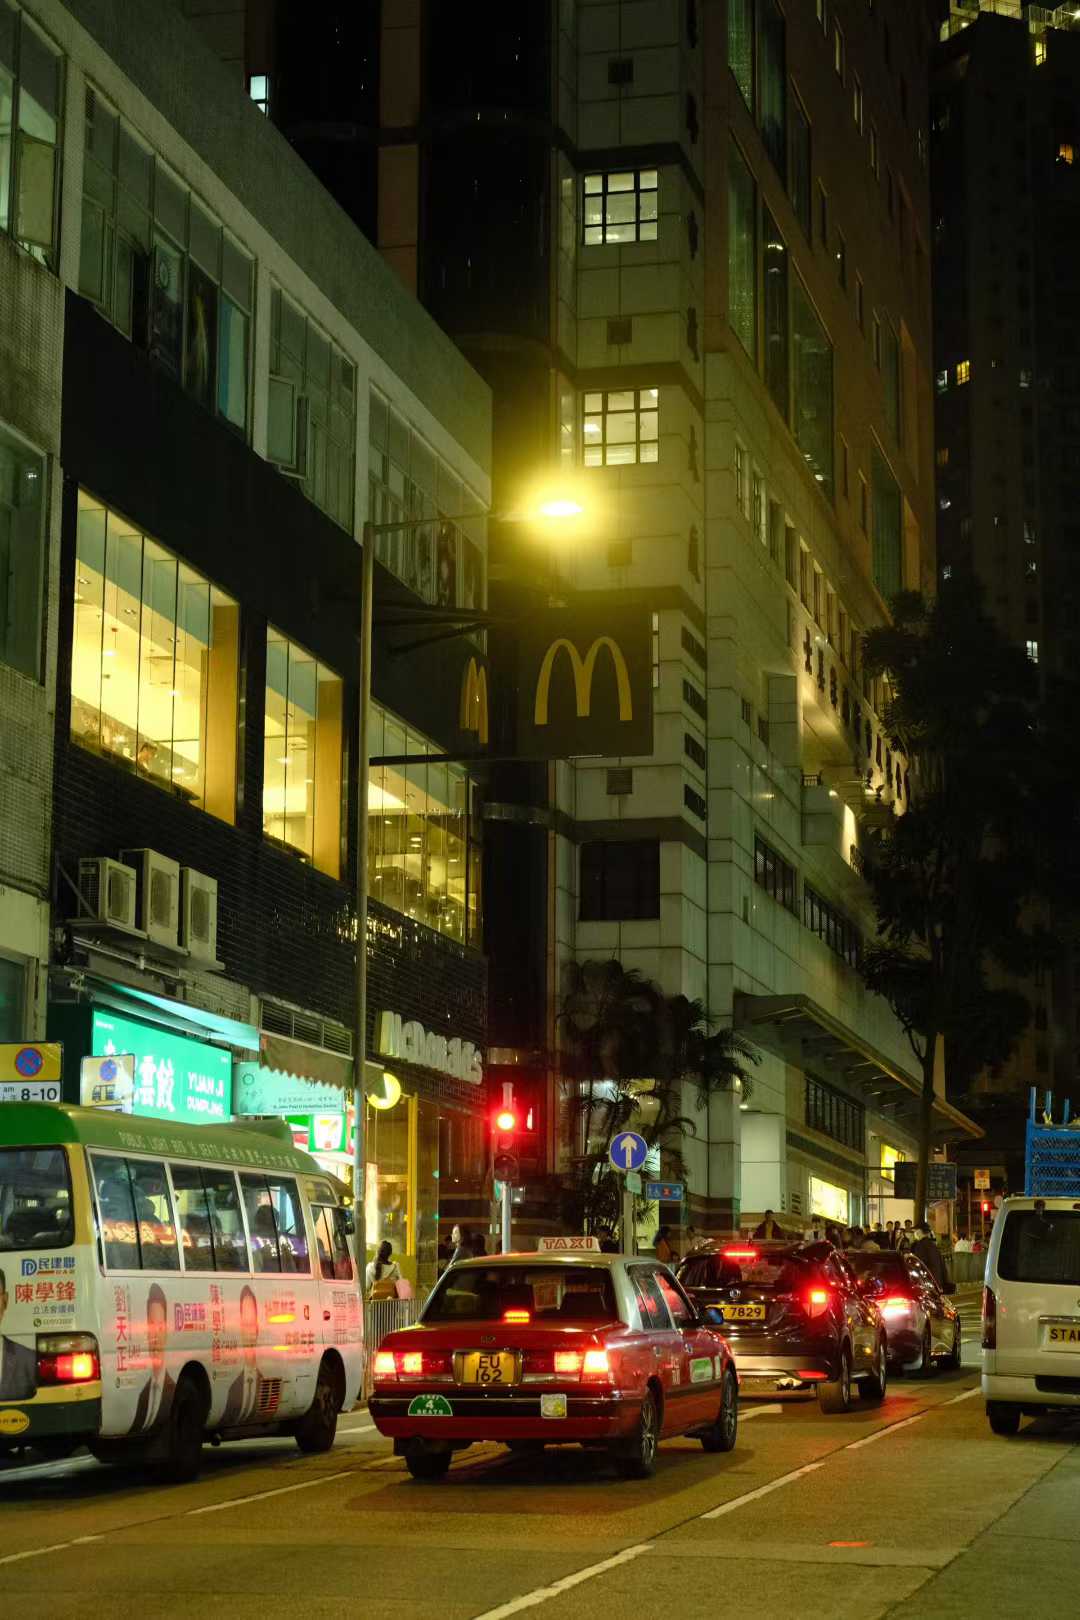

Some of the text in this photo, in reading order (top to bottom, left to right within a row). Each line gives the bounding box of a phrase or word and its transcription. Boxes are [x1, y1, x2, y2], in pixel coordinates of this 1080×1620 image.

[21, 1087, 57, 1101] 8-10
[543, 1237, 593, 1249] TAXI
[15, 1280, 76, 1304] 陳學鋒
[730, 1307, 761, 1317] 7829
[1050, 1328, 1080, 1341] STA
[479, 1355, 501, 1369] EU
[475, 1369, 502, 1382] 162
[425, 1399, 434, 1409] 4
